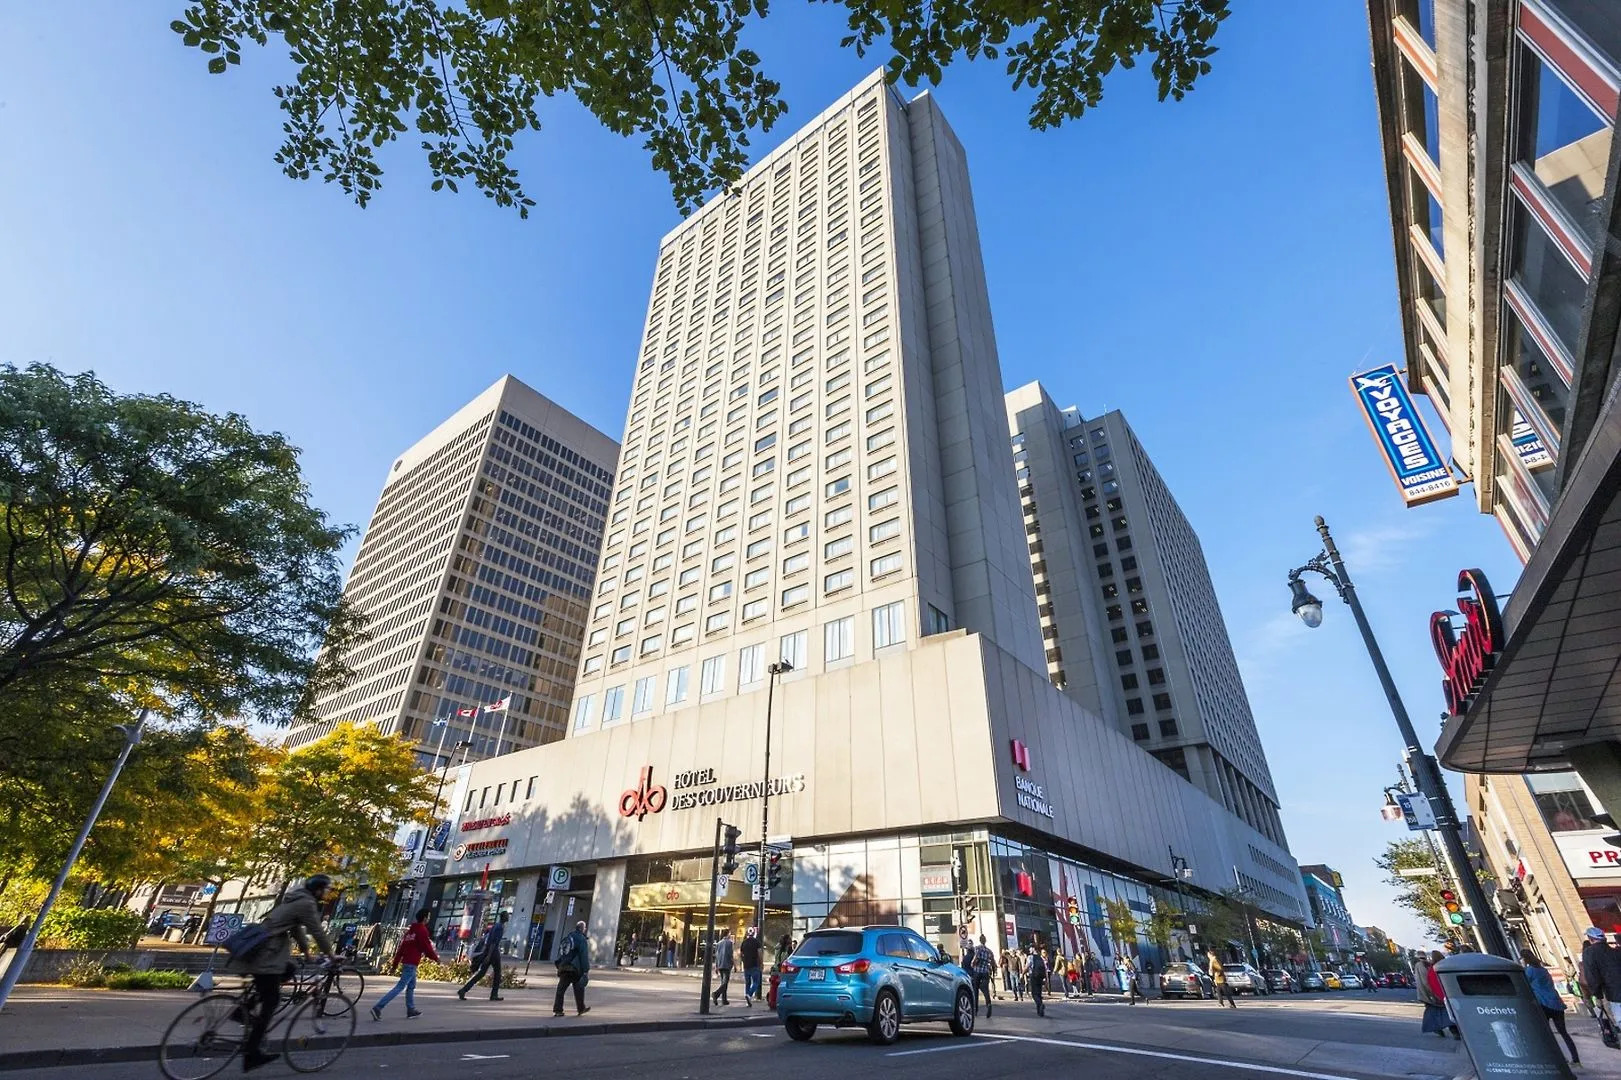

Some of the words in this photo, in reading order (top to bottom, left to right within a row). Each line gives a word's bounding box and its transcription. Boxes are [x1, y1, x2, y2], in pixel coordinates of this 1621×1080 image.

[1368, 385, 1429, 470] VOYAGES
[1400, 467, 1447, 486] VOISINE
[1015, 776, 1044, 799] BANQUE
[1017, 793, 1055, 819] NATIONALE
[1588, 850, 1621, 864] PR
